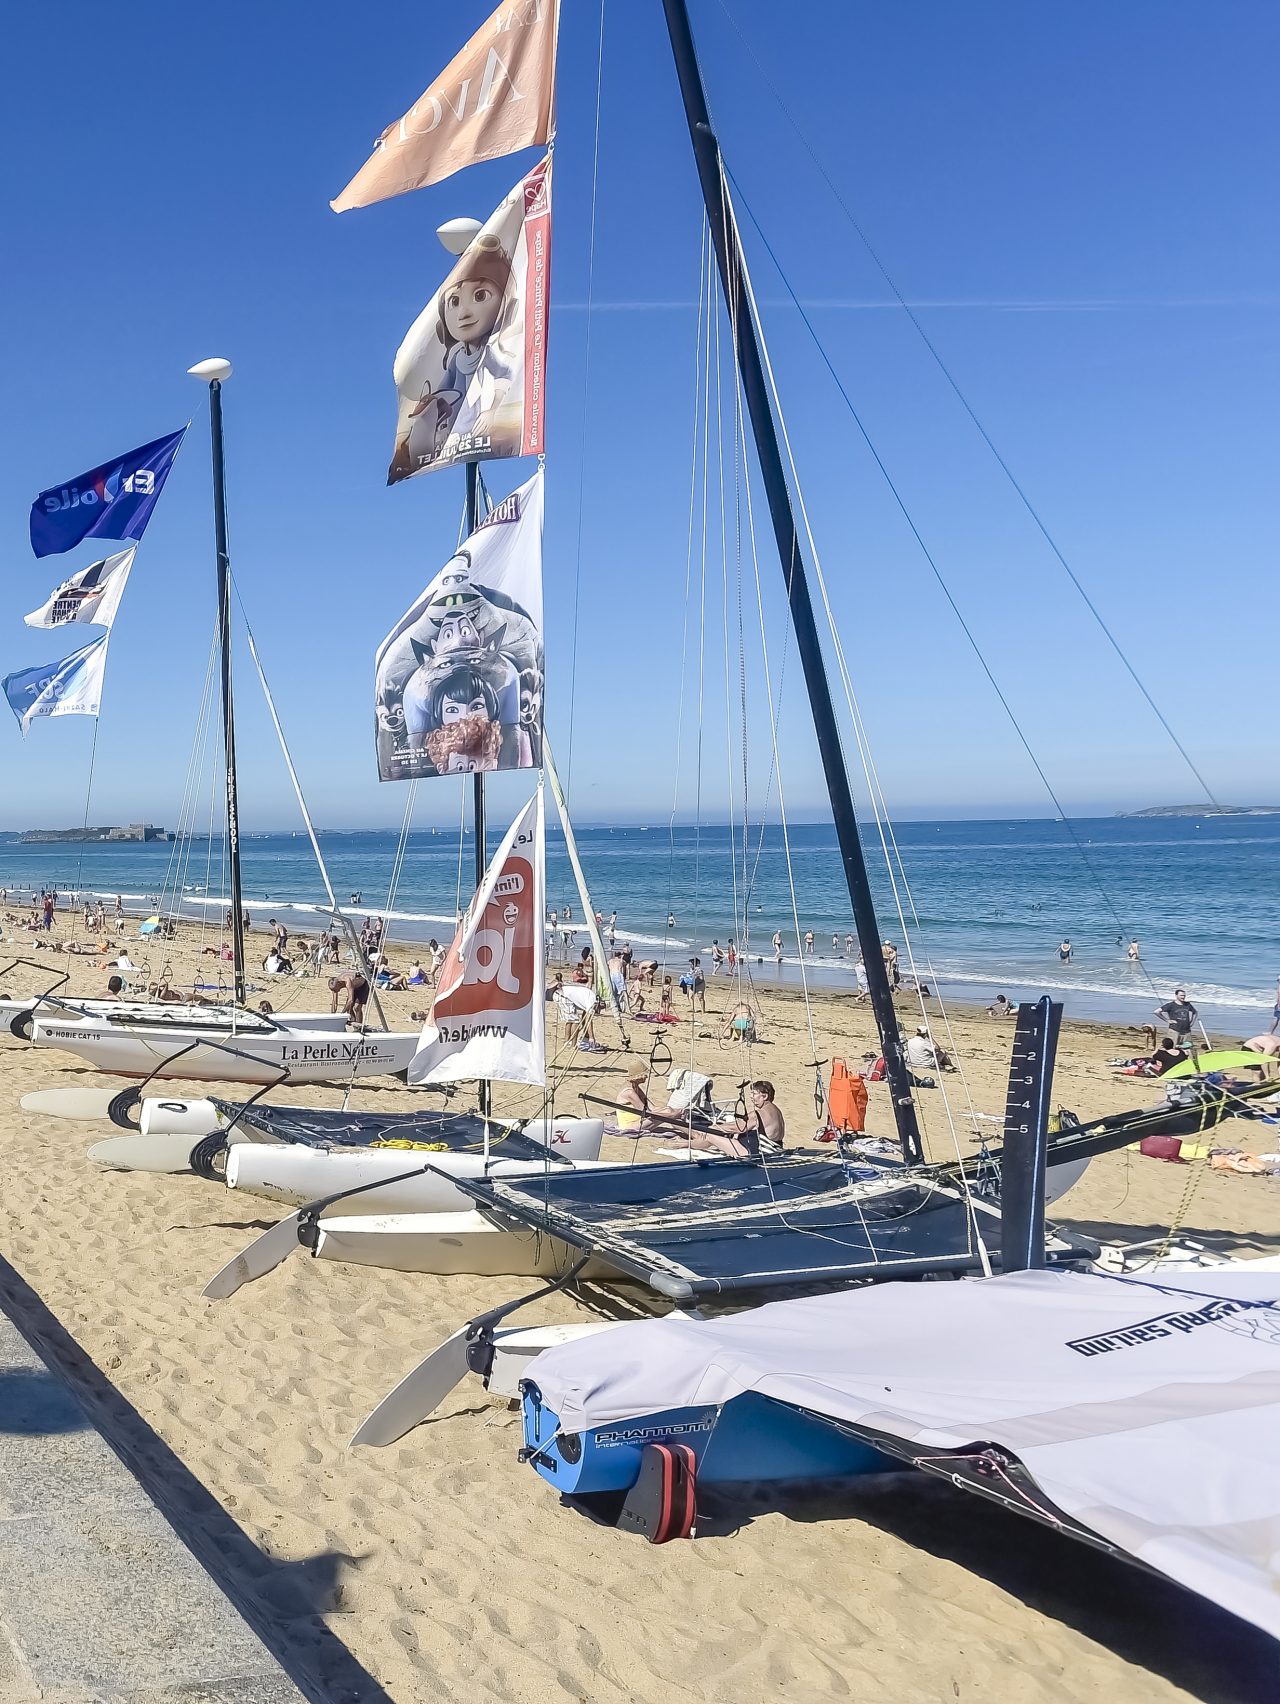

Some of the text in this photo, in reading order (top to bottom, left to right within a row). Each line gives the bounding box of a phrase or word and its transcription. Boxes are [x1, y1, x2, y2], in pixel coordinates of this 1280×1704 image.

[55, 1031, 76, 1039] HOBIE
[1033, 1027, 1038, 1036] 1
[281, 1045, 299, 1060] La
[304, 1043, 338, 1060] Perle
[1027, 1052, 1036, 1060] 2
[1024, 1076, 1033, 1084] 3
[1022, 1100, 1031, 1109] 4
[1019, 1124, 1028, 1133] 5
[595, 1422, 711, 1444] PHANTOM
